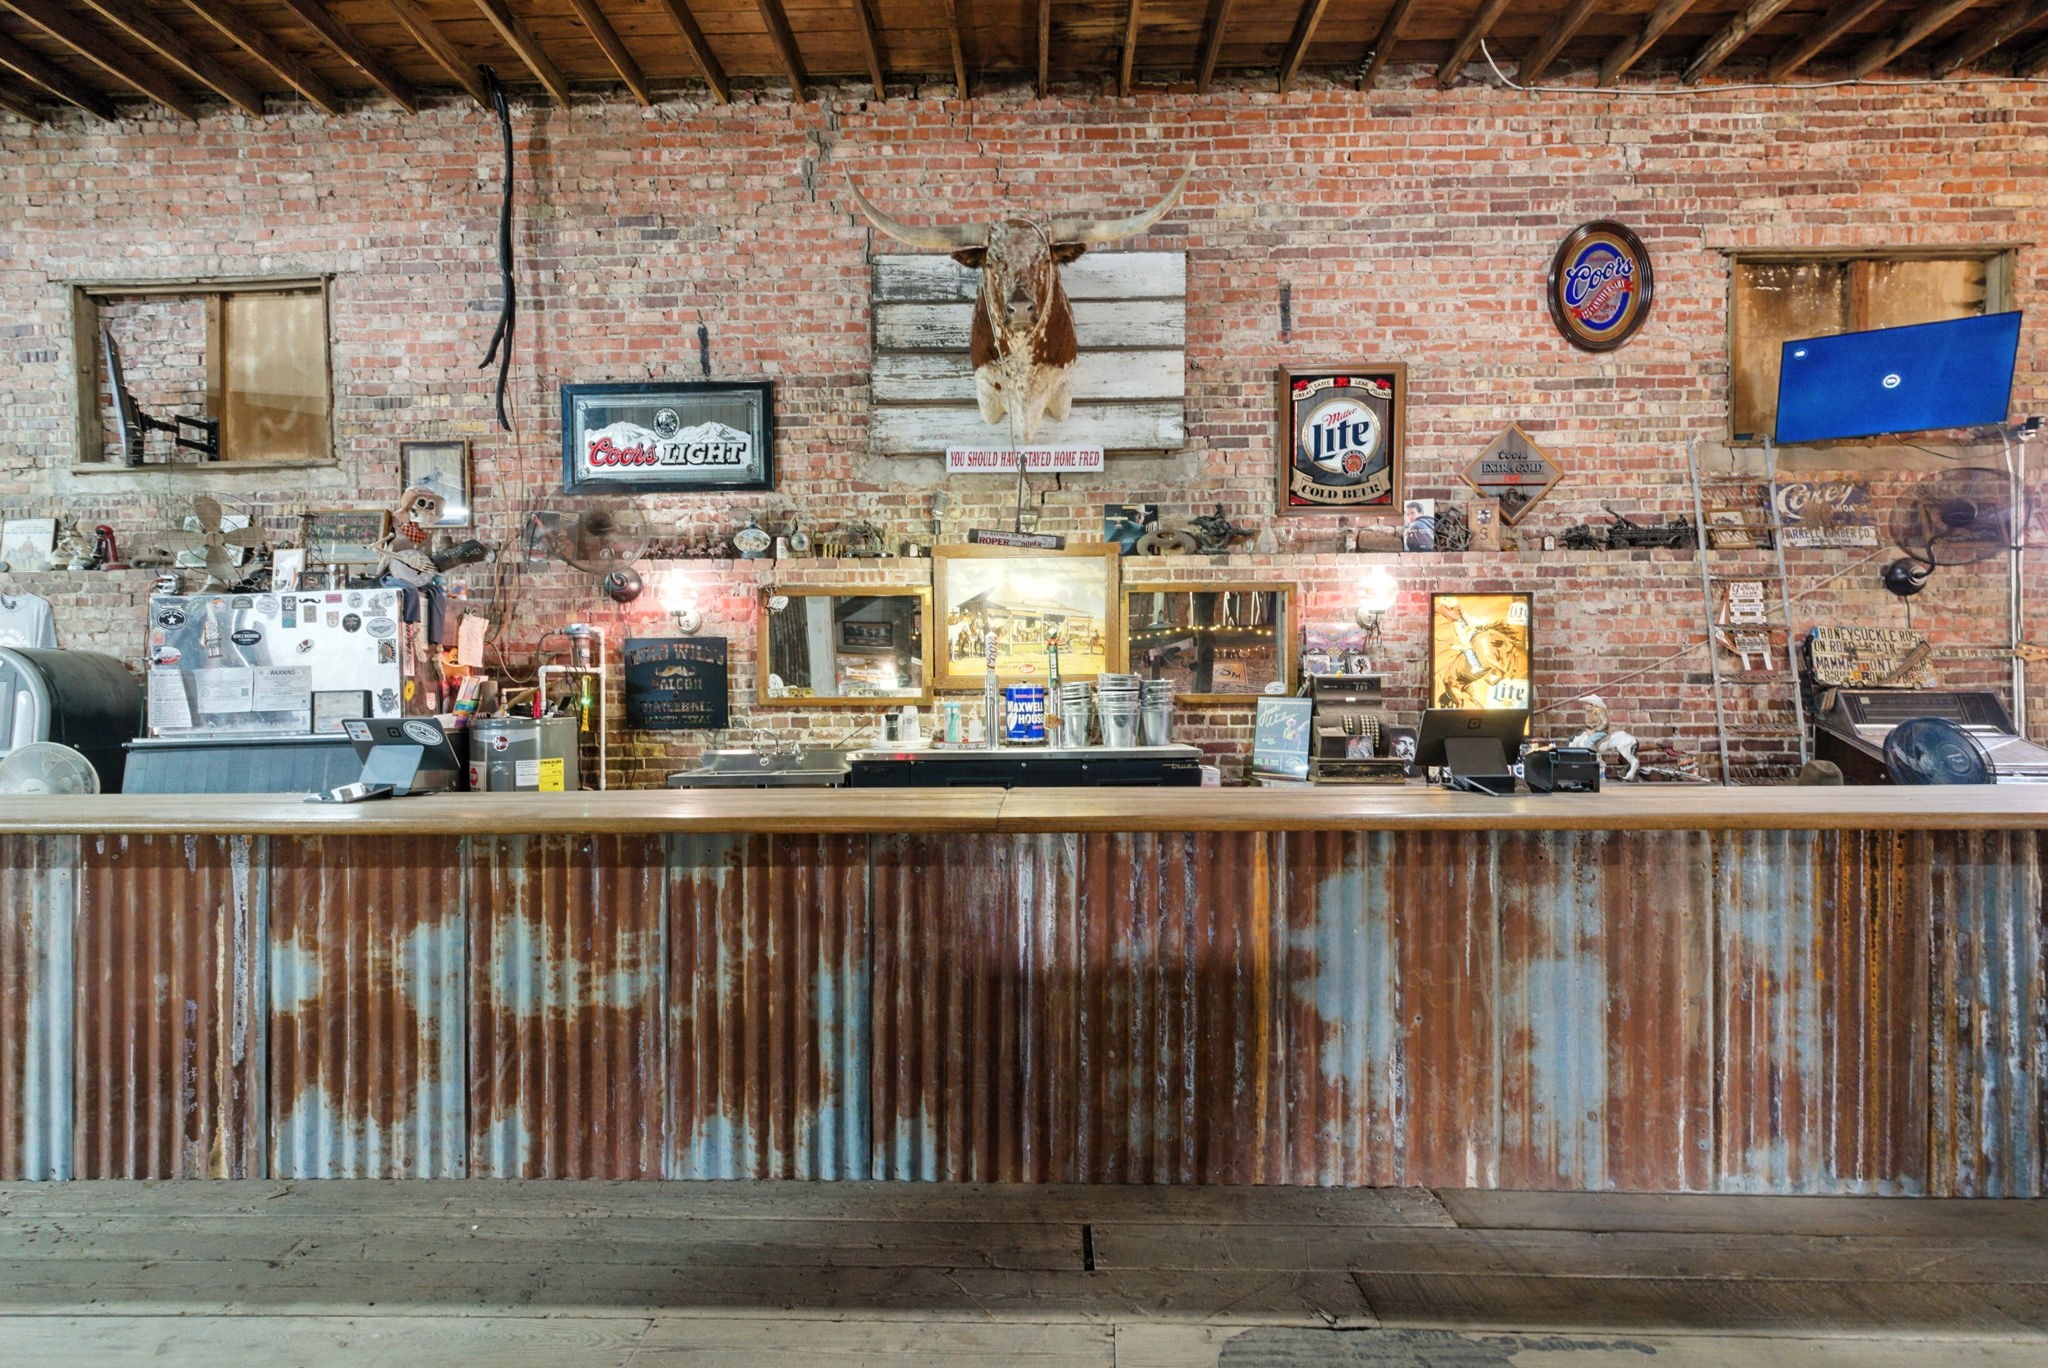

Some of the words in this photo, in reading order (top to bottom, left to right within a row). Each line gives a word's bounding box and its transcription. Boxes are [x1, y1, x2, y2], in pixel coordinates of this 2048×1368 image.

[1564, 257, 1634, 306] Coors
[1294, 390, 1312, 399] GREAT
[1313, 380, 1331, 388] TASTE
[1370, 387, 1391, 398] FILLING
[1322, 408, 1358, 426] Miller
[1312, 420, 1370, 462] Lite
[588, 437, 660, 467] Coors
[660, 441, 746, 466] LIGHT
[950, 451, 966, 467] YOU
[967, 451, 998, 467] SHOULD
[1000, 451, 1022, 467] HAVE
[1024, 451, 1051, 467] STAYED
[1053, 451, 1077, 467] HOME
[1078, 451, 1100, 467] FRED
[1498, 449, 1528, 460] Coors
[1481, 463, 1514, 473] EXTRA
[1515, 463, 1543, 473] GOLD
[1301, 485, 1338, 499] COLD
[1342, 483, 1381, 499] BEER
[979, 537, 1010, 546] ROPER
[1819, 627, 1897, 643] HONEYSUCKLE
[986, 637, 997, 670] Coors
[1814, 640, 1826, 651] ON
[1815, 656, 1853, 670] MAMMA
[1493, 684, 1525, 703] Lite
[1007, 700, 1043, 712] MAXWELL
[1018, 714, 1044, 724] HOUSE
